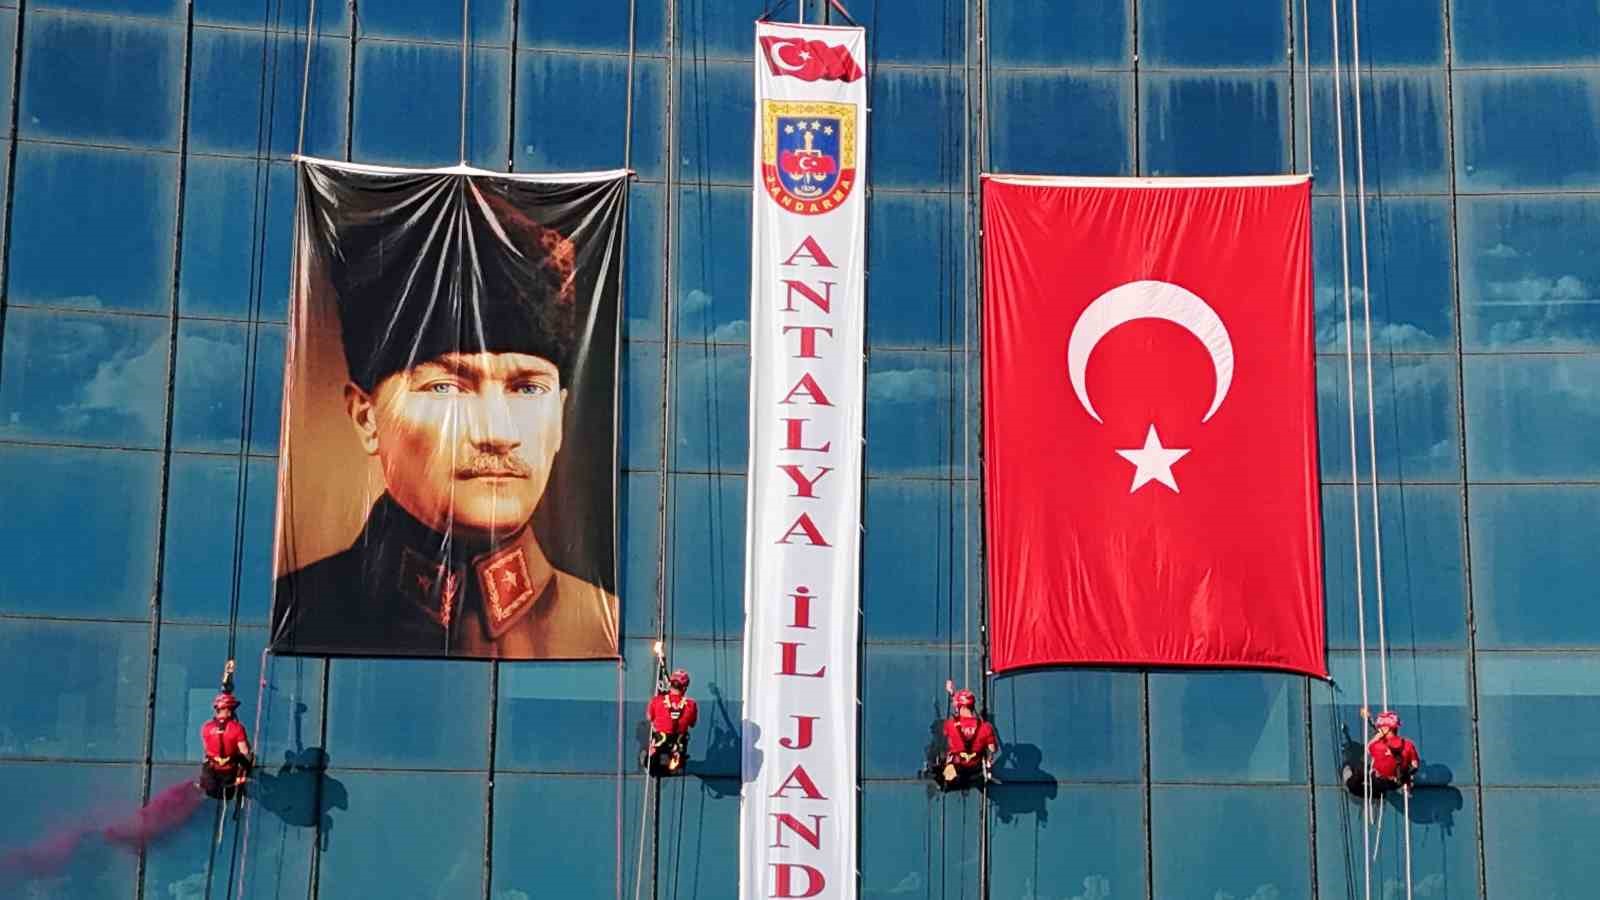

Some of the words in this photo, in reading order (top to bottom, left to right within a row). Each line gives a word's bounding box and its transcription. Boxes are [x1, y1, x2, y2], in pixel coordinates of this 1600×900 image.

[765, 174, 850, 213] JANDARMA
[774, 235, 838, 547] ANTALYA
[774, 586, 826, 678] İL
[768, 715, 828, 899] JAND
